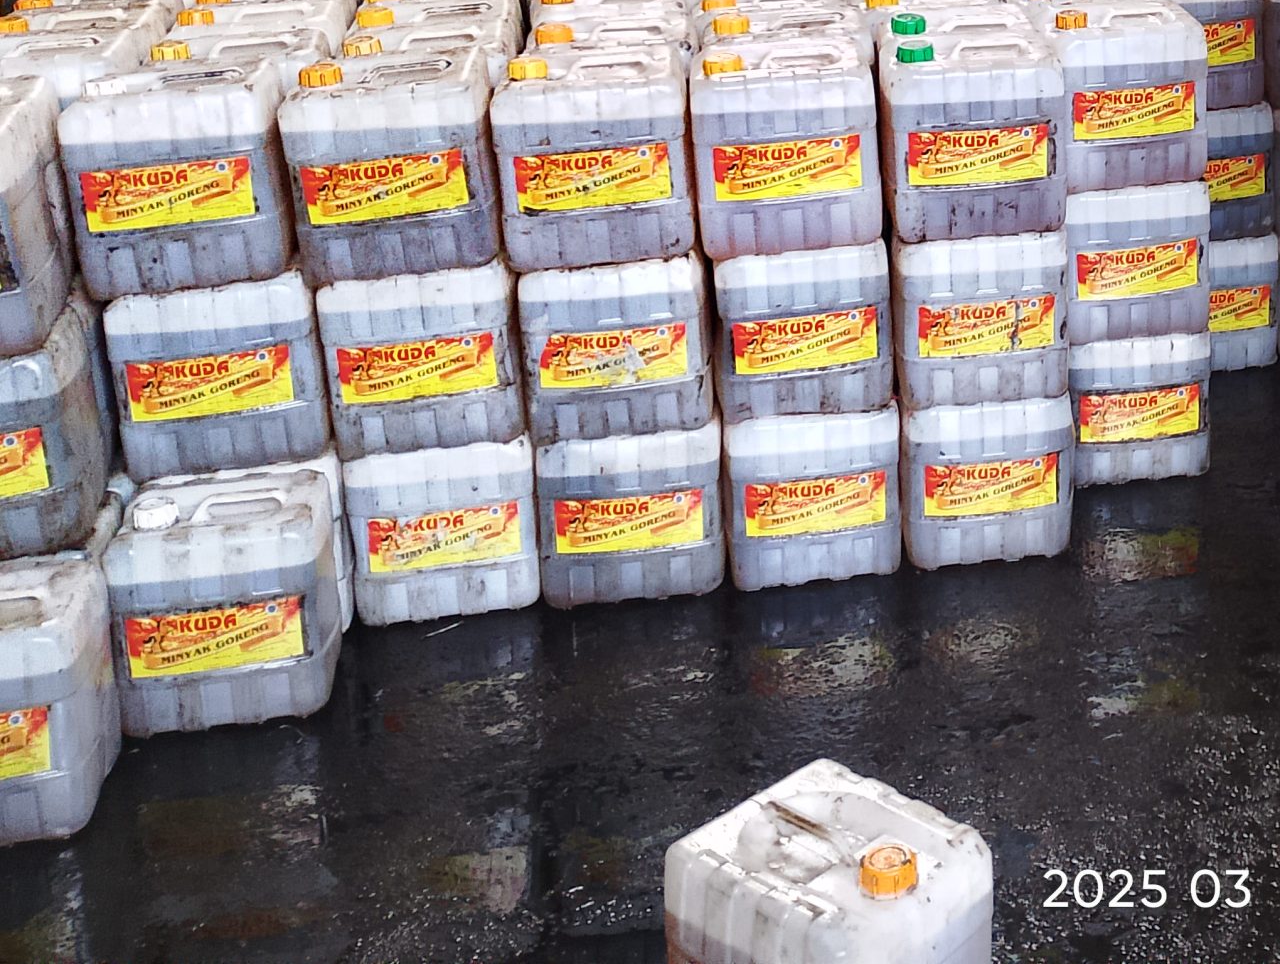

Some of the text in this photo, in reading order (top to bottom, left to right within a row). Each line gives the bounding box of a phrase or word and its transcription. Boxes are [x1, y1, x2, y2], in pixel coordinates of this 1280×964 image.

[1113, 93, 1154, 106] KUDA
[1097, 100, 1175, 130] MINYAK GORENG
[952, 134, 999, 148] KUDA
[758, 146, 807, 162] KUDA
[934, 145, 1023, 174] MINYAK GORENG
[349, 163, 404, 181] KUDA
[561, 155, 613, 172] KUDA
[1206, 162, 1230, 174] UDA
[133, 169, 189, 186] KUDA
[741, 156, 835, 190] MINYAK GORENG
[1216, 170, 1248, 187] GORENG
[545, 166, 641, 201] MINYAK GORENG
[116, 180, 220, 218] MINYAK GORENG
[335, 173, 434, 212] MINYAK GORENG
[1115, 250, 1155, 264] KUDA
[1101, 258, 1177, 290] MINYAK GORENG
[1209, 294, 1235, 304] UDA
[960, 306, 1006, 318] KUDA
[1220, 301, 1253, 316] GORENG
[780, 319, 825, 335] KUDA
[583, 335, 632, 350] KUDA
[761, 328, 851, 364] MINYAK GORENG
[944, 333, 985, 347] MINYAK
[383, 345, 436, 362] KUDA
[174, 361, 229, 379] KUDA
[368, 354, 465, 391] MINYAK GORENG
[566, 362, 610, 377] MINYAK
[159, 370, 260, 410] MINYAK GORENG
[1119, 395, 1158, 408] KUDA
[1102, 403, 1179, 434] MINYAK GORENG
[966, 466, 1011, 479] KUDA
[788, 484, 835, 498] KUDA
[949, 475, 1035, 506] MINYAK GORENG
[601, 501, 649, 517] KUDA
[771, 492, 860, 526] MINYAK GORENG
[414, 516, 464, 532] KUDA
[583, 510, 676, 544] MINYAK GORENG
[397, 542, 441, 561] MINYAK
[180, 613, 237, 633] KUDA
[161, 623, 270, 665] MINYAK GORENG
